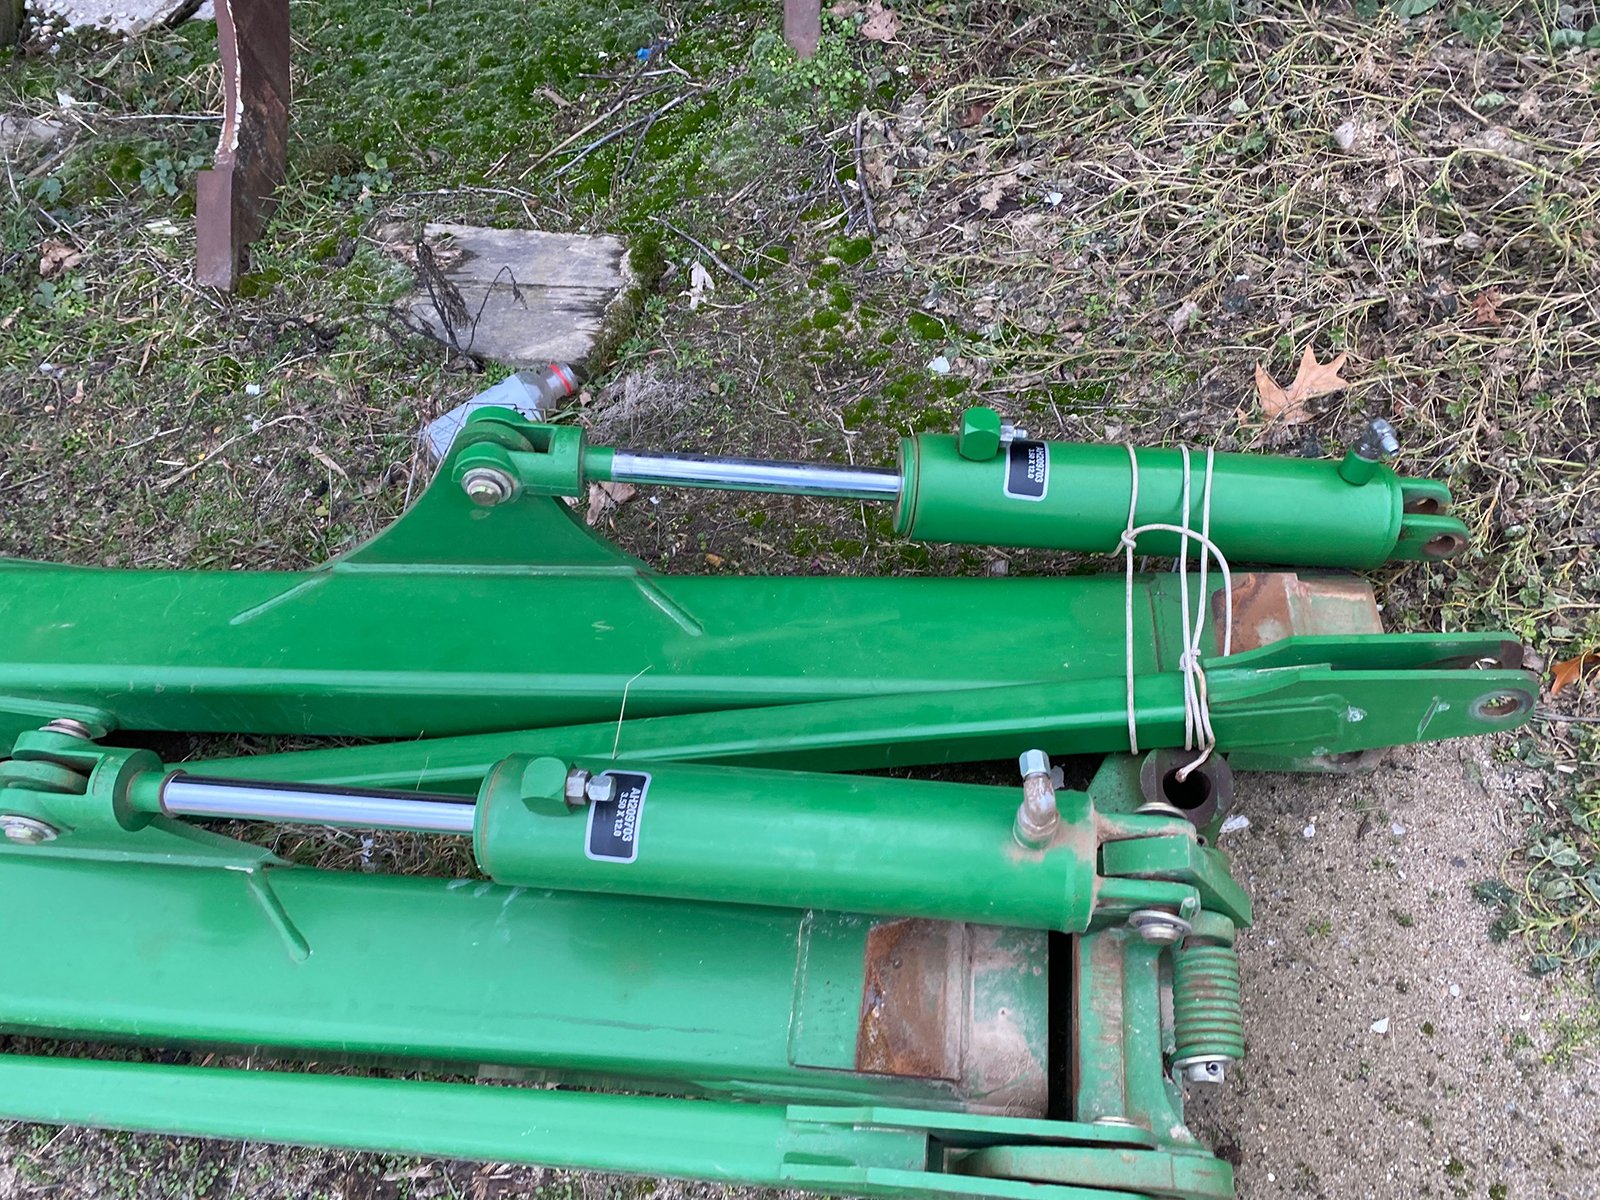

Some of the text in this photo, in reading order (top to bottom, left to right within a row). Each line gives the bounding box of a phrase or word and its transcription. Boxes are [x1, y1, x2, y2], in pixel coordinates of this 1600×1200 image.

[618, 791, 629, 809] 3.50
[621, 787, 641, 842] AH209703
[613, 818, 624, 837] 12.0
